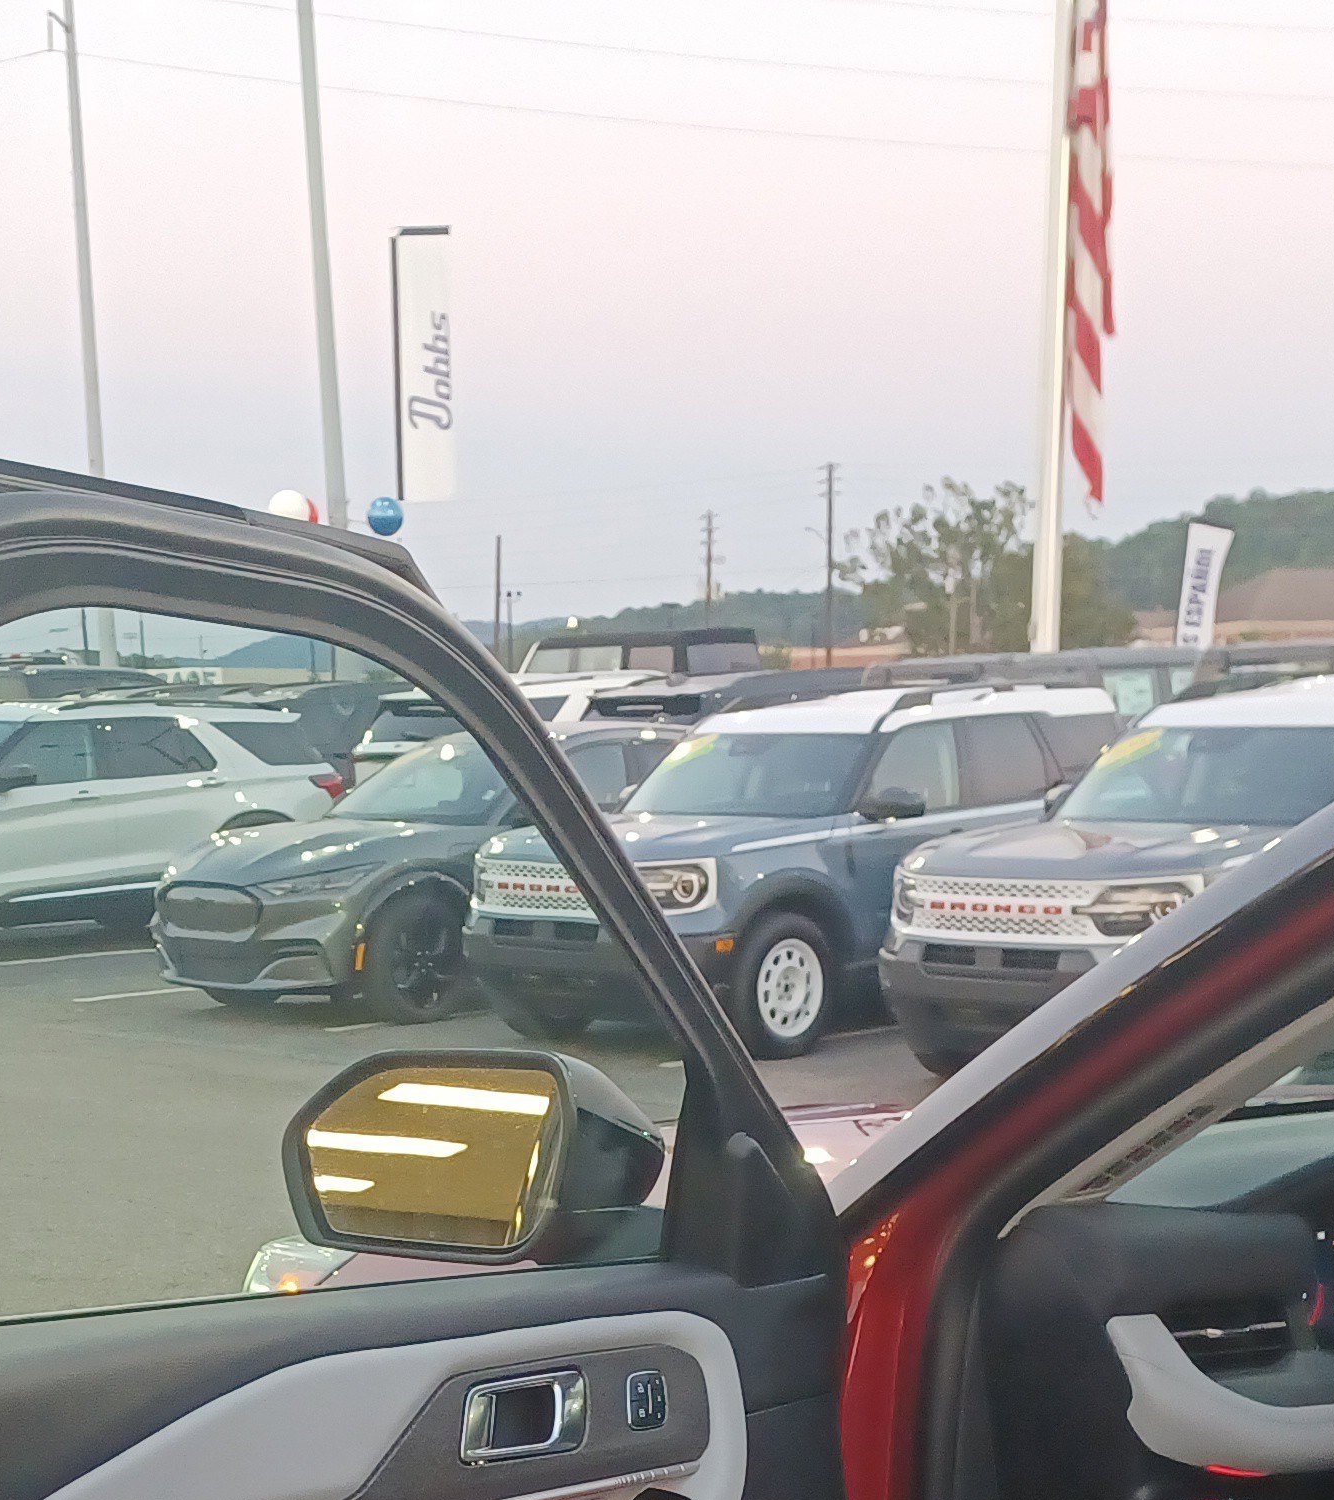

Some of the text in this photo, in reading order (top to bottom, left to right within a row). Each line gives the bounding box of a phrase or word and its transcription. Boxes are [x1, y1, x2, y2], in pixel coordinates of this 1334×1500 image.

[407, 310, 453, 430] Dobbs
[497, 882, 581, 893] BRONC
[930, 901, 1063, 915] BRONCO
